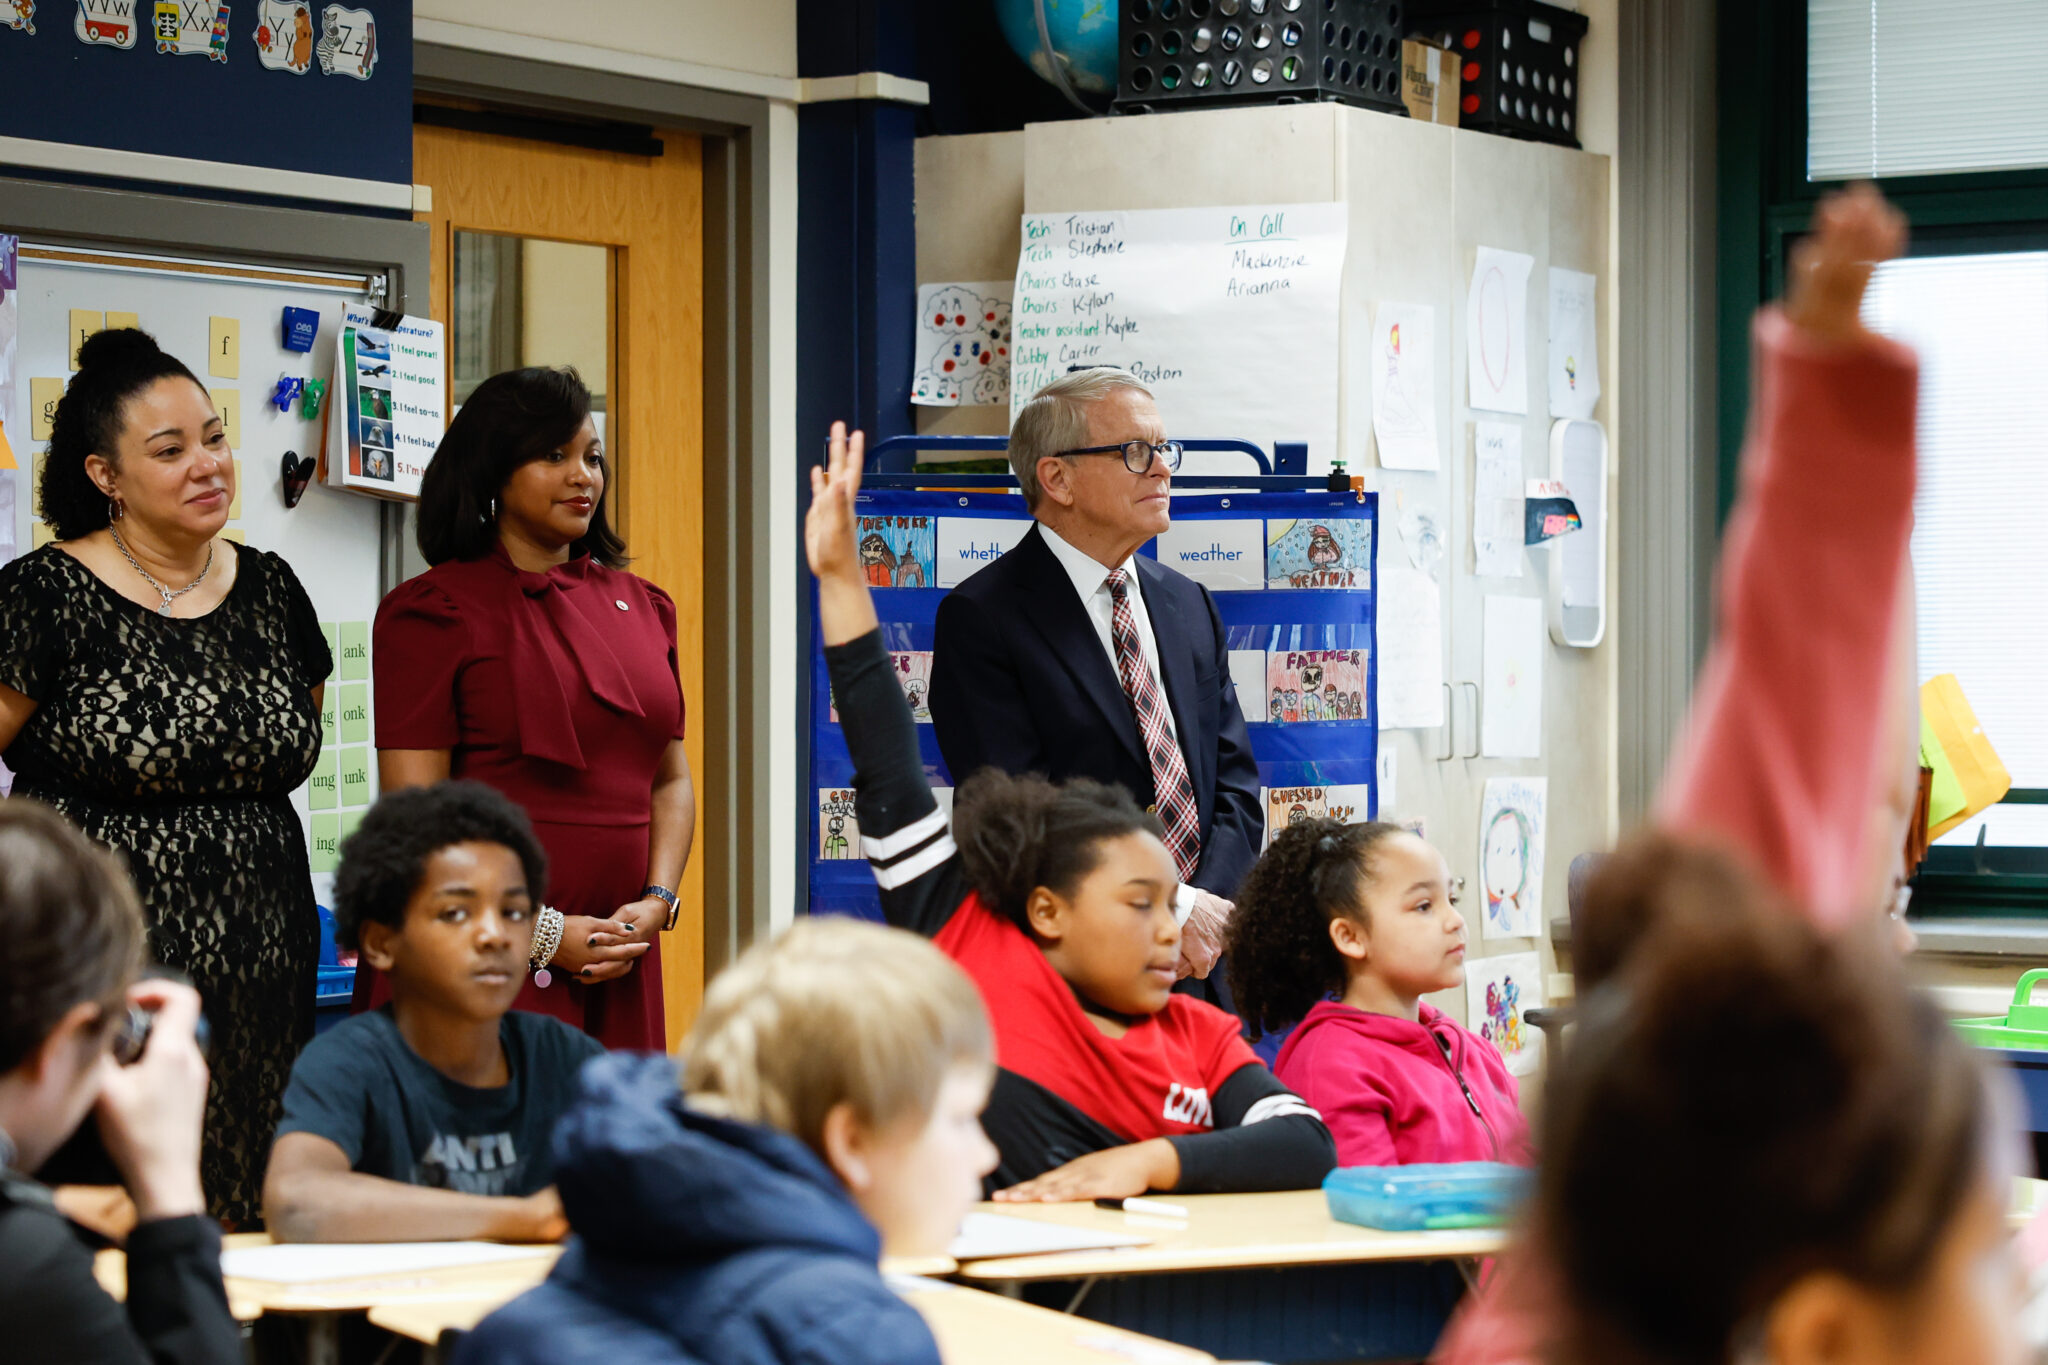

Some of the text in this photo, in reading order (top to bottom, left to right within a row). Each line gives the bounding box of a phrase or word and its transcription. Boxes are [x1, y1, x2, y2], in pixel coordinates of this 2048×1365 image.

[1230, 212, 1285, 238] On Call
[1227, 277, 1291, 297] Arianna
[396, 325, 434, 338] perature?
[222, 336, 230, 355] f
[401, 345, 415, 355] feel
[1059, 343, 1102, 363] Carter
[404, 372, 417, 382] feel
[43, 400, 56, 424] g
[404, 404, 418, 415] feel
[407, 435, 421, 446] feel
[959, 541, 1004, 561] wheth
[1179, 542, 1244, 561] weather
[343, 643, 366, 659] ank
[343, 705, 365, 721] onk
[312, 774, 335, 791] ung
[344, 768, 367, 785] unk
[316, 836, 335, 855] ing
[422, 1131, 517, 1171] ANTI
